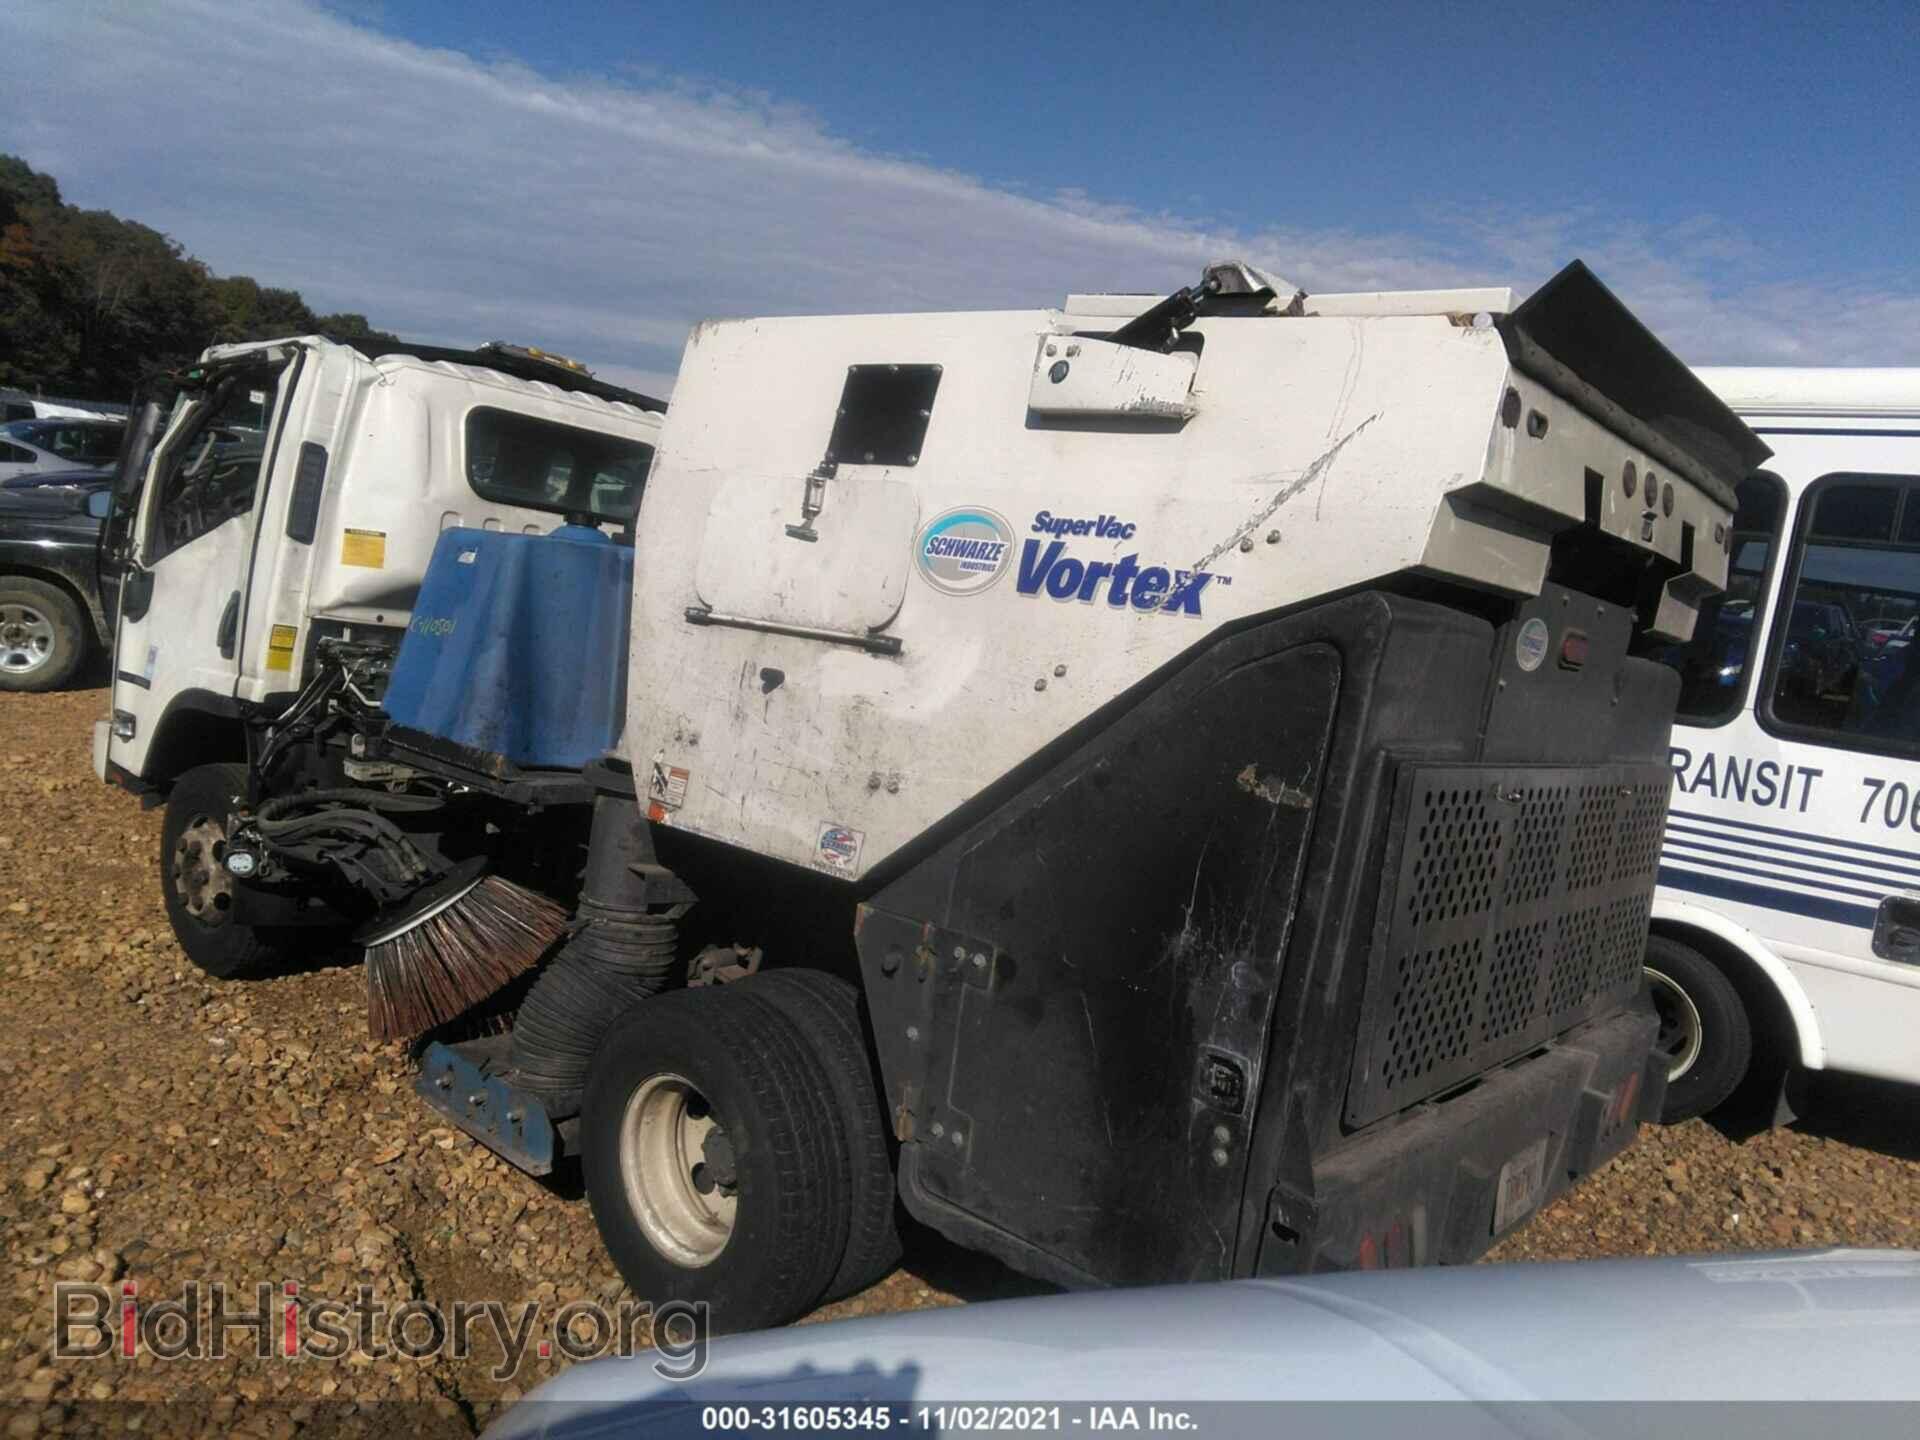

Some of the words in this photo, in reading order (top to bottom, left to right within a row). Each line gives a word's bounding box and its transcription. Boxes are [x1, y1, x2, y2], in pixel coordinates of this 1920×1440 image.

[1031, 510, 1137, 540] SuperVac
[926, 536, 1005, 562] SCHWARZE
[959, 561, 997, 573] INDUSTRIES
[1016, 538, 1215, 618] Vortex
